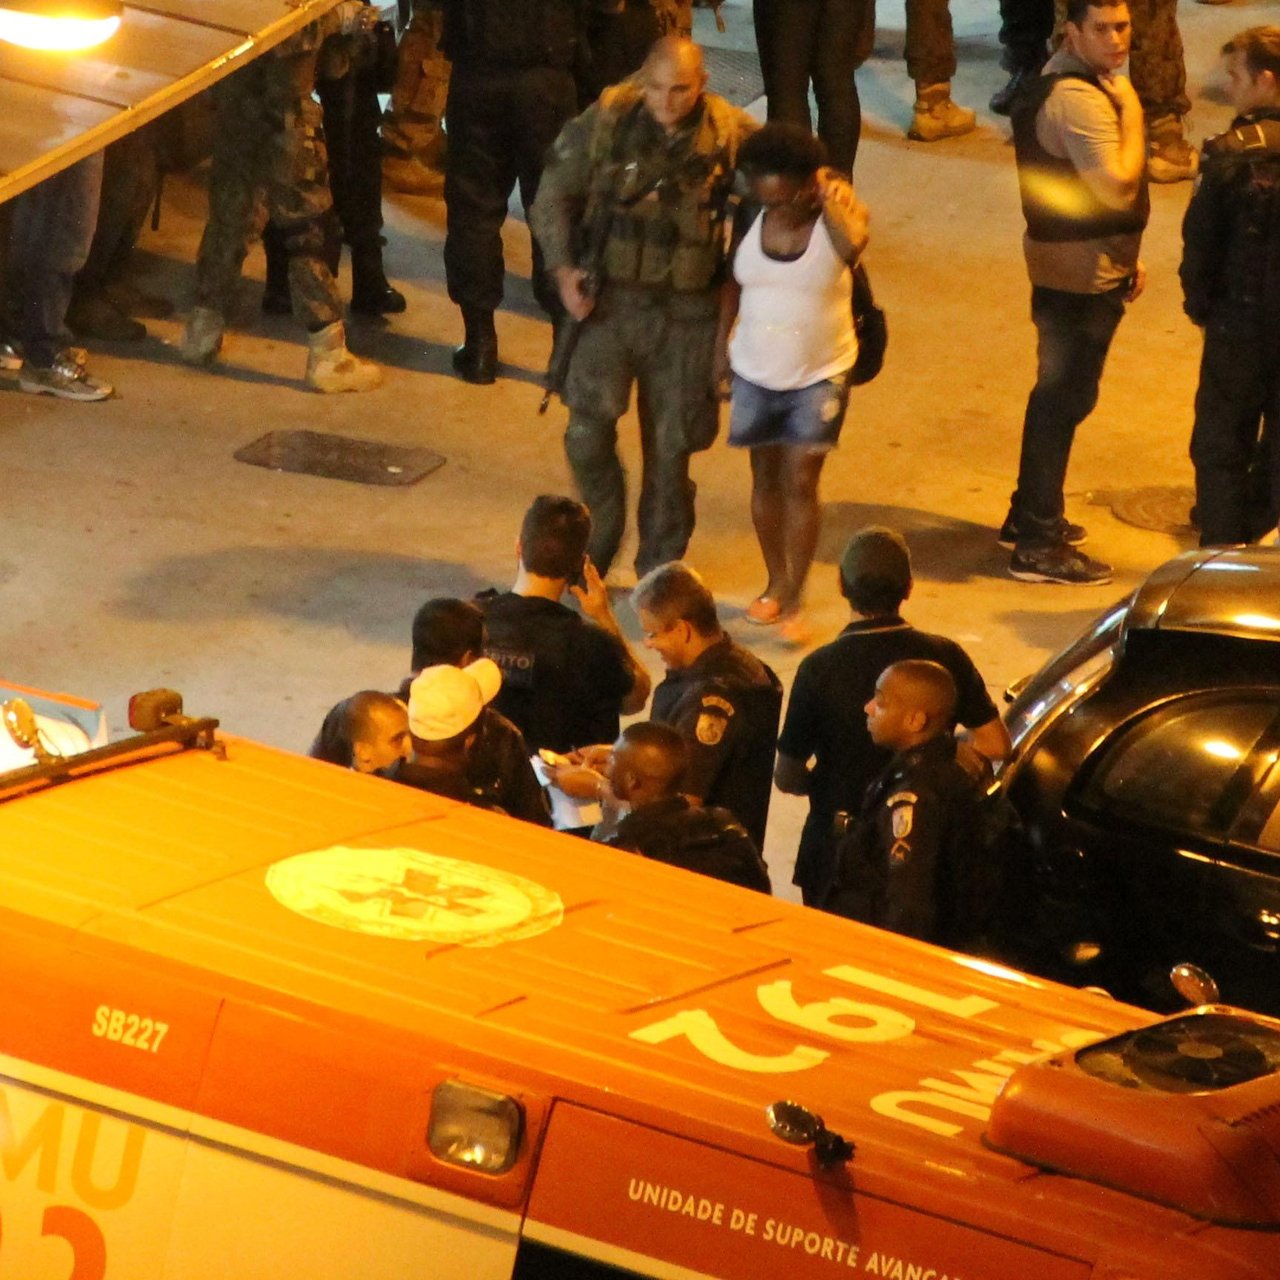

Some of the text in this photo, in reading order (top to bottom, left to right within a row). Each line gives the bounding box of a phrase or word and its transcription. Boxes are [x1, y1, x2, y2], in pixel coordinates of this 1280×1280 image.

[91, 1004, 169, 1053] SB227
[628, 1177, 966, 1280] UNIDADE DE SUPORTE AVANÇ
